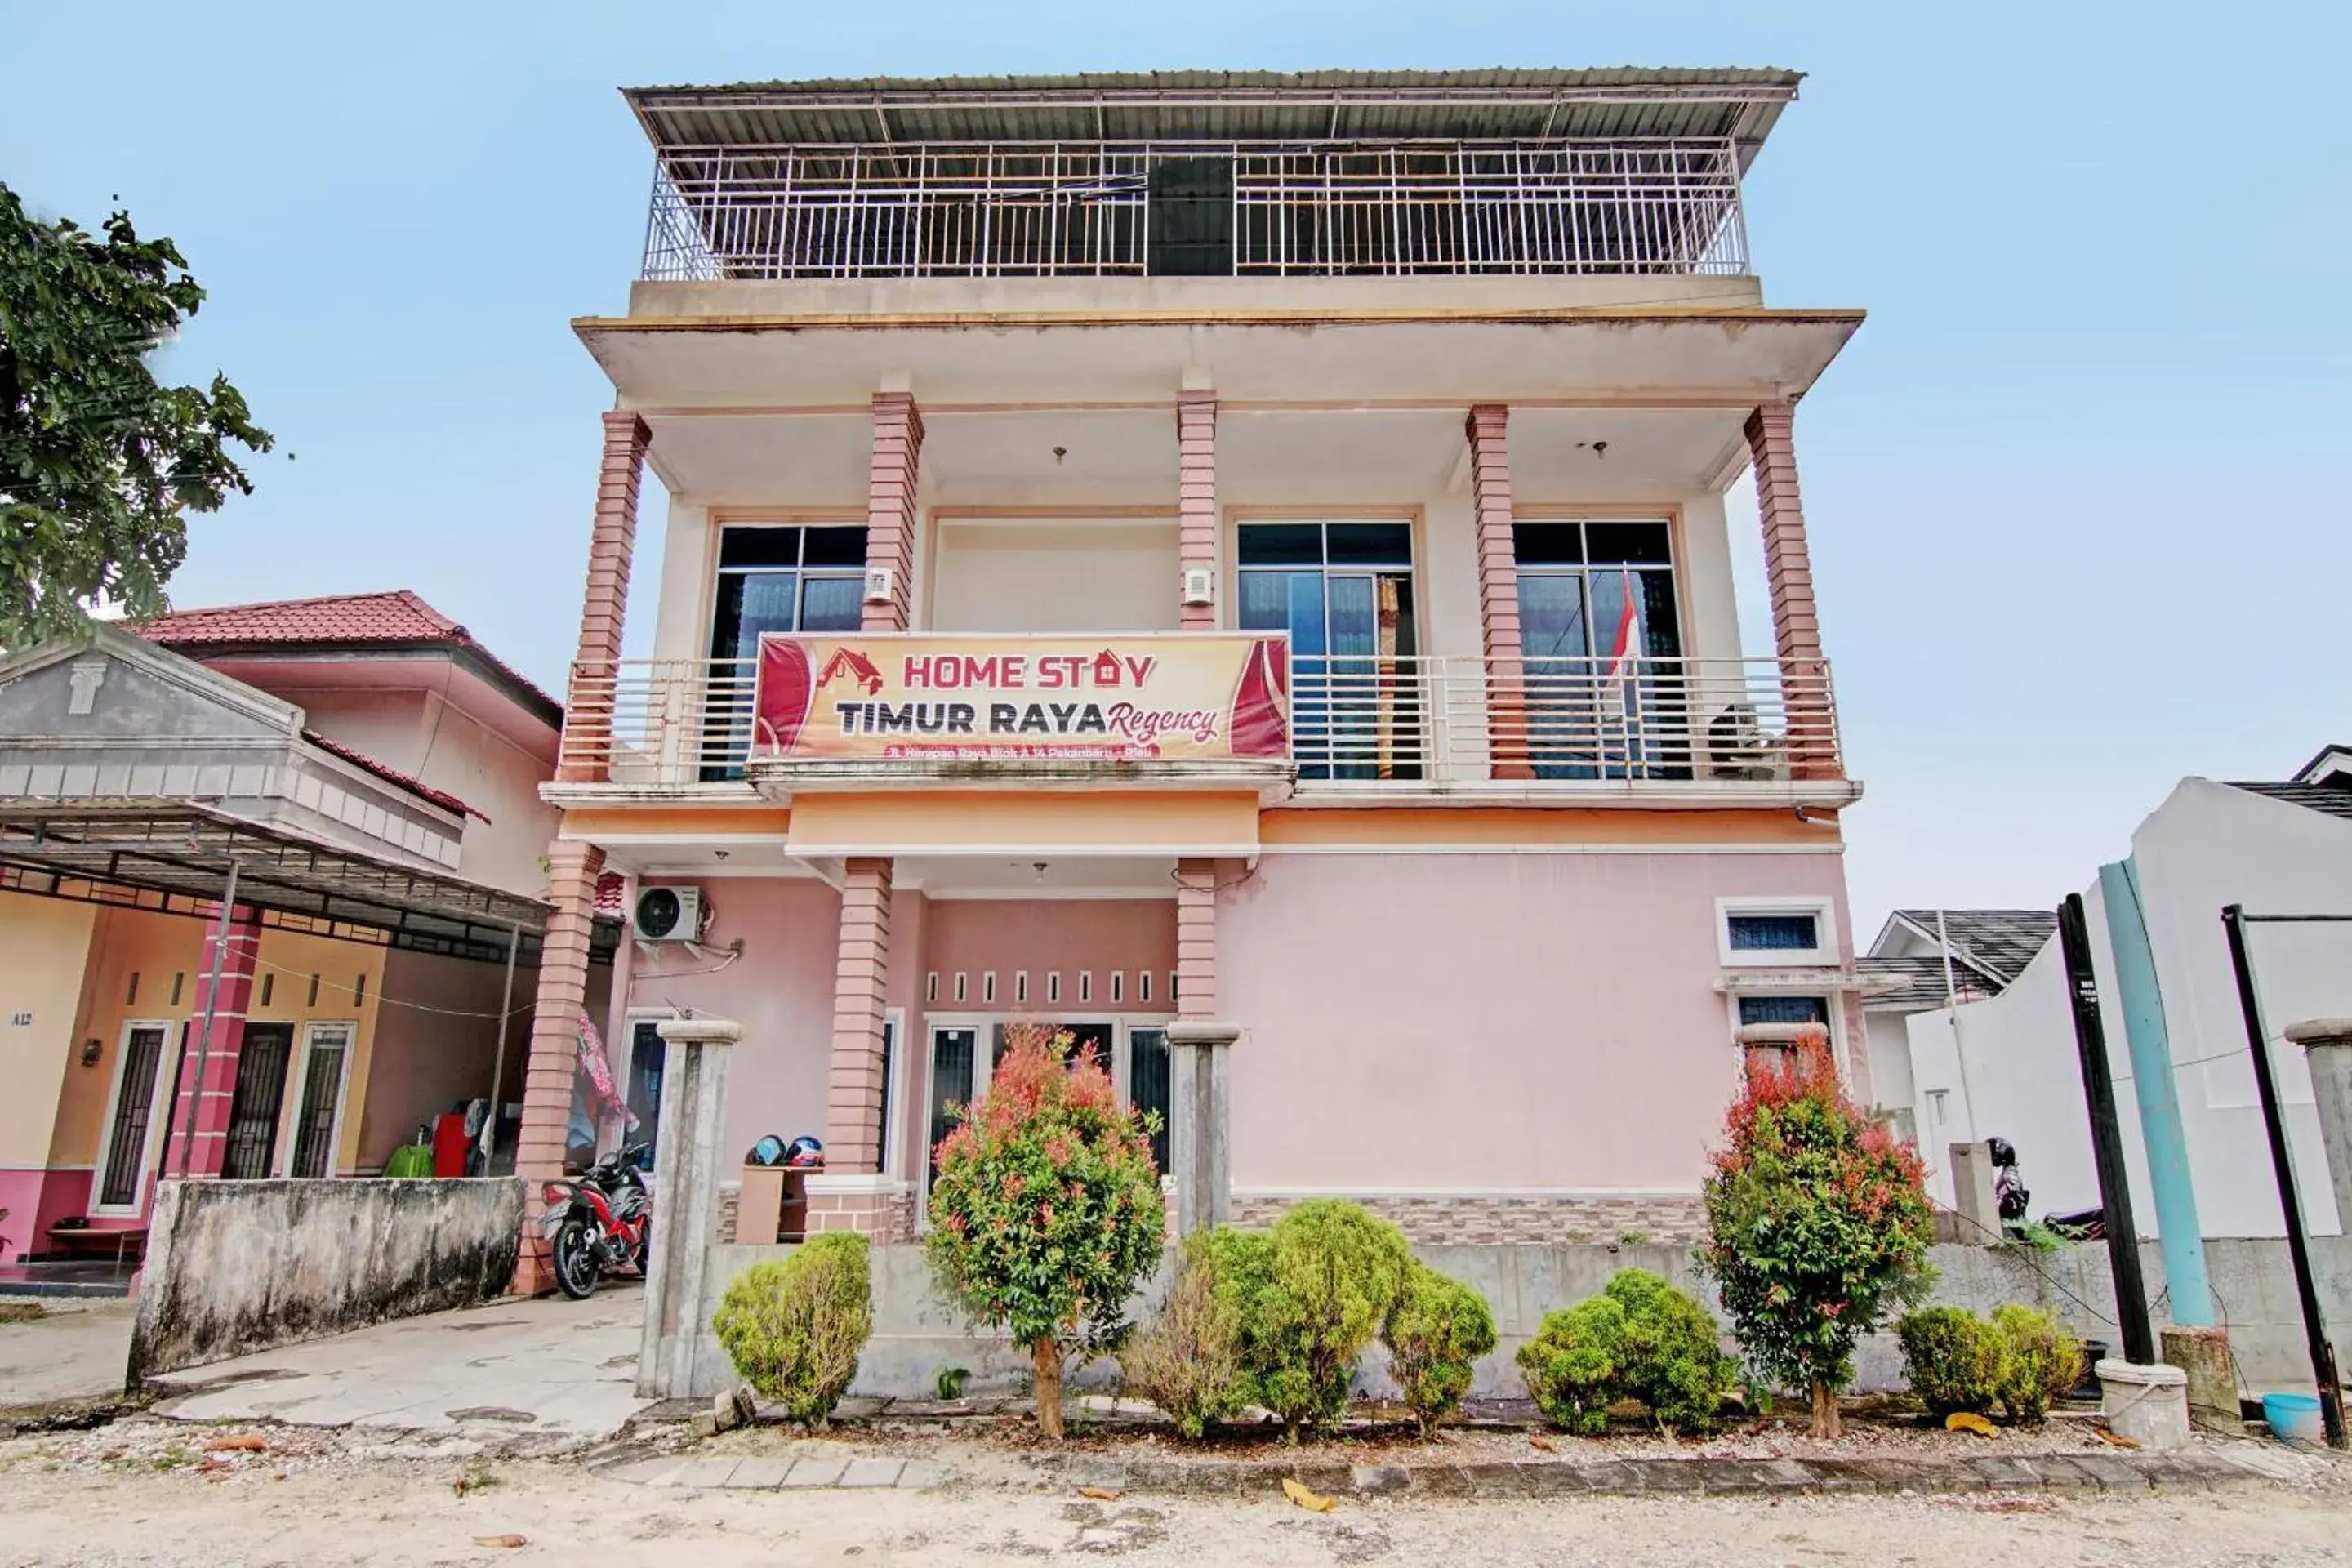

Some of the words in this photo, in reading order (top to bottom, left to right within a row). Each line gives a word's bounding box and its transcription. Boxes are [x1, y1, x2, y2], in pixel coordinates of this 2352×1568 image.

[904, 656, 1022, 688] HOME
[836, 702, 976, 733] TIMUR
[989, 702, 1107, 733] RAYA
[1107, 701, 1218, 742] Regency
